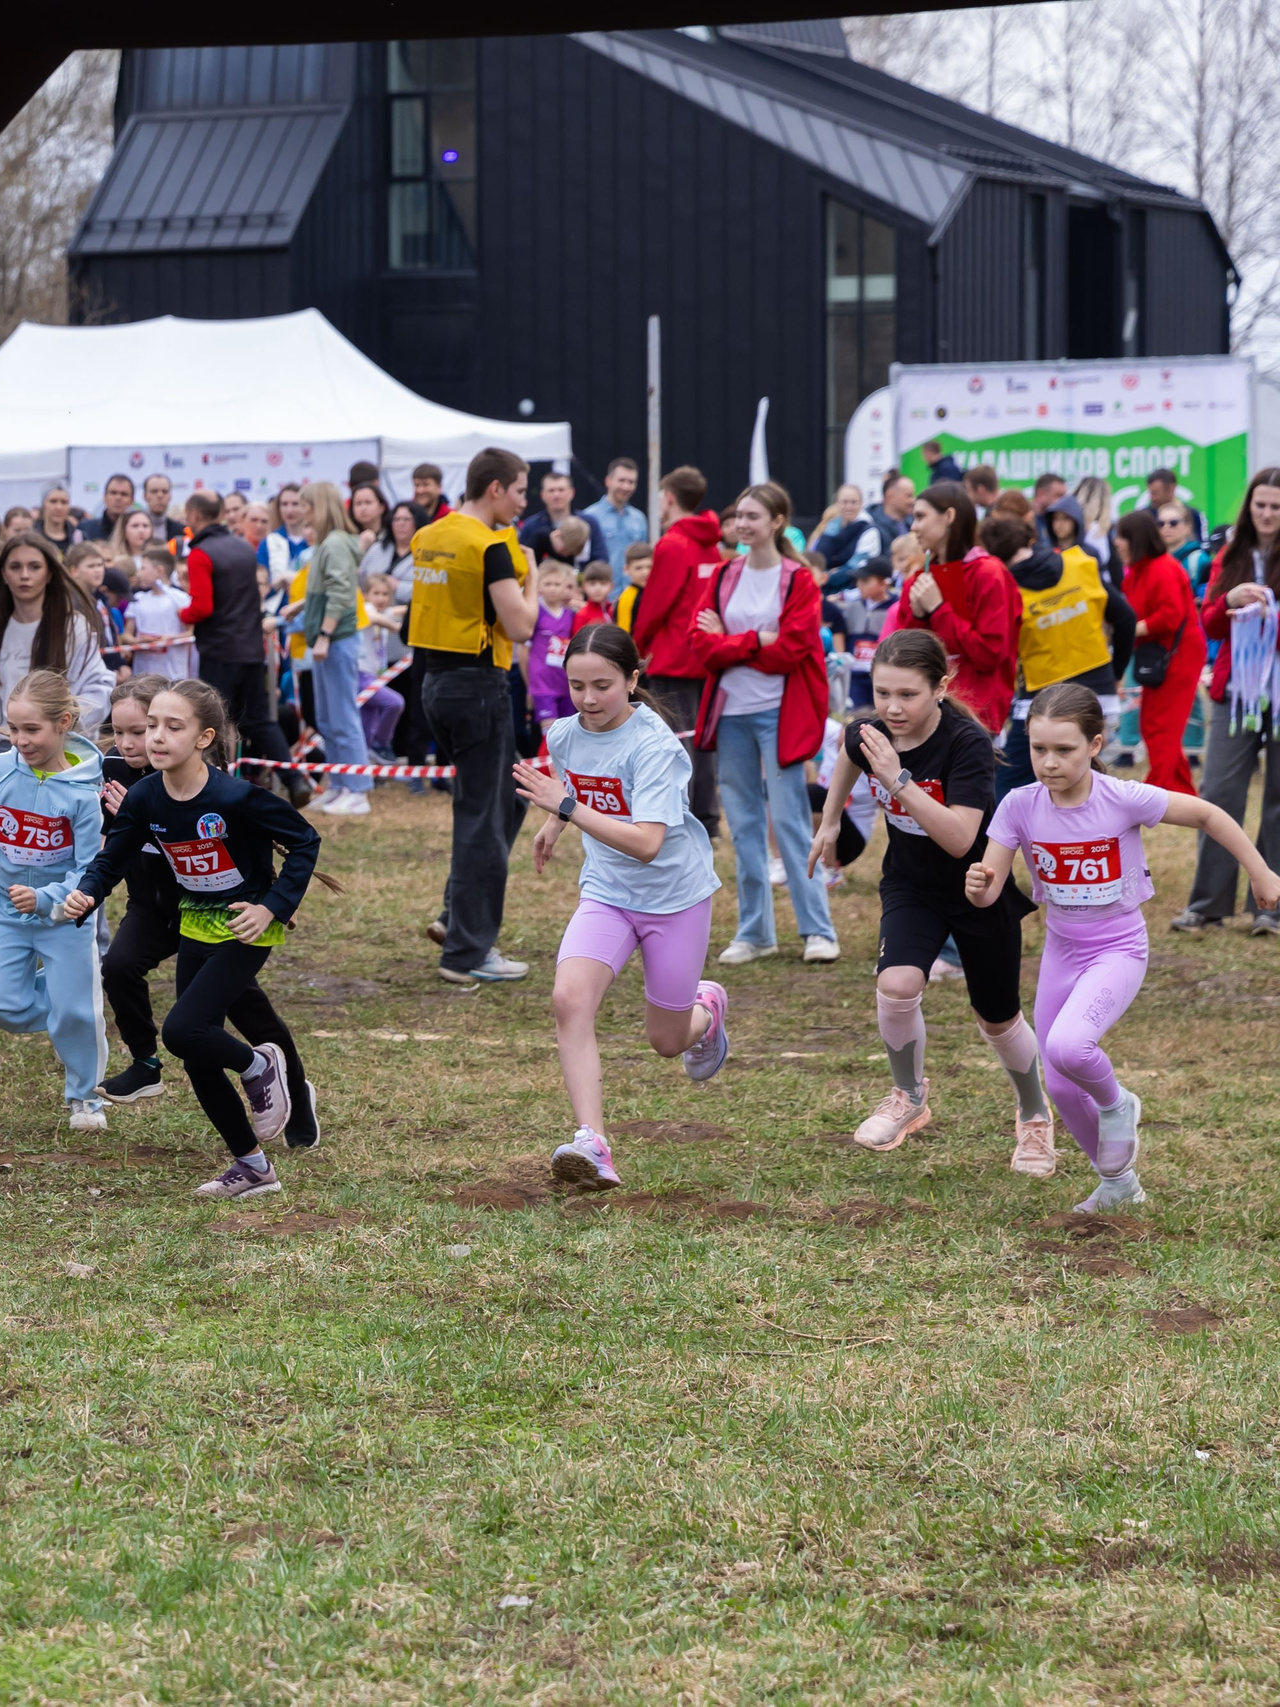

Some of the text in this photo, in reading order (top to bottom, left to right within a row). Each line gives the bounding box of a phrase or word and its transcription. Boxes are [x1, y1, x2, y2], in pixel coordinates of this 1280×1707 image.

[1114, 445, 1194, 479] СПОРТ
[580, 790, 621, 812] 759
[23, 825, 64, 847] 756
[197, 842, 214, 850] 2025
[1090, 844, 1110, 853] 2025
[177, 850, 219, 873] 757
[1063, 857, 1109, 881] 761
